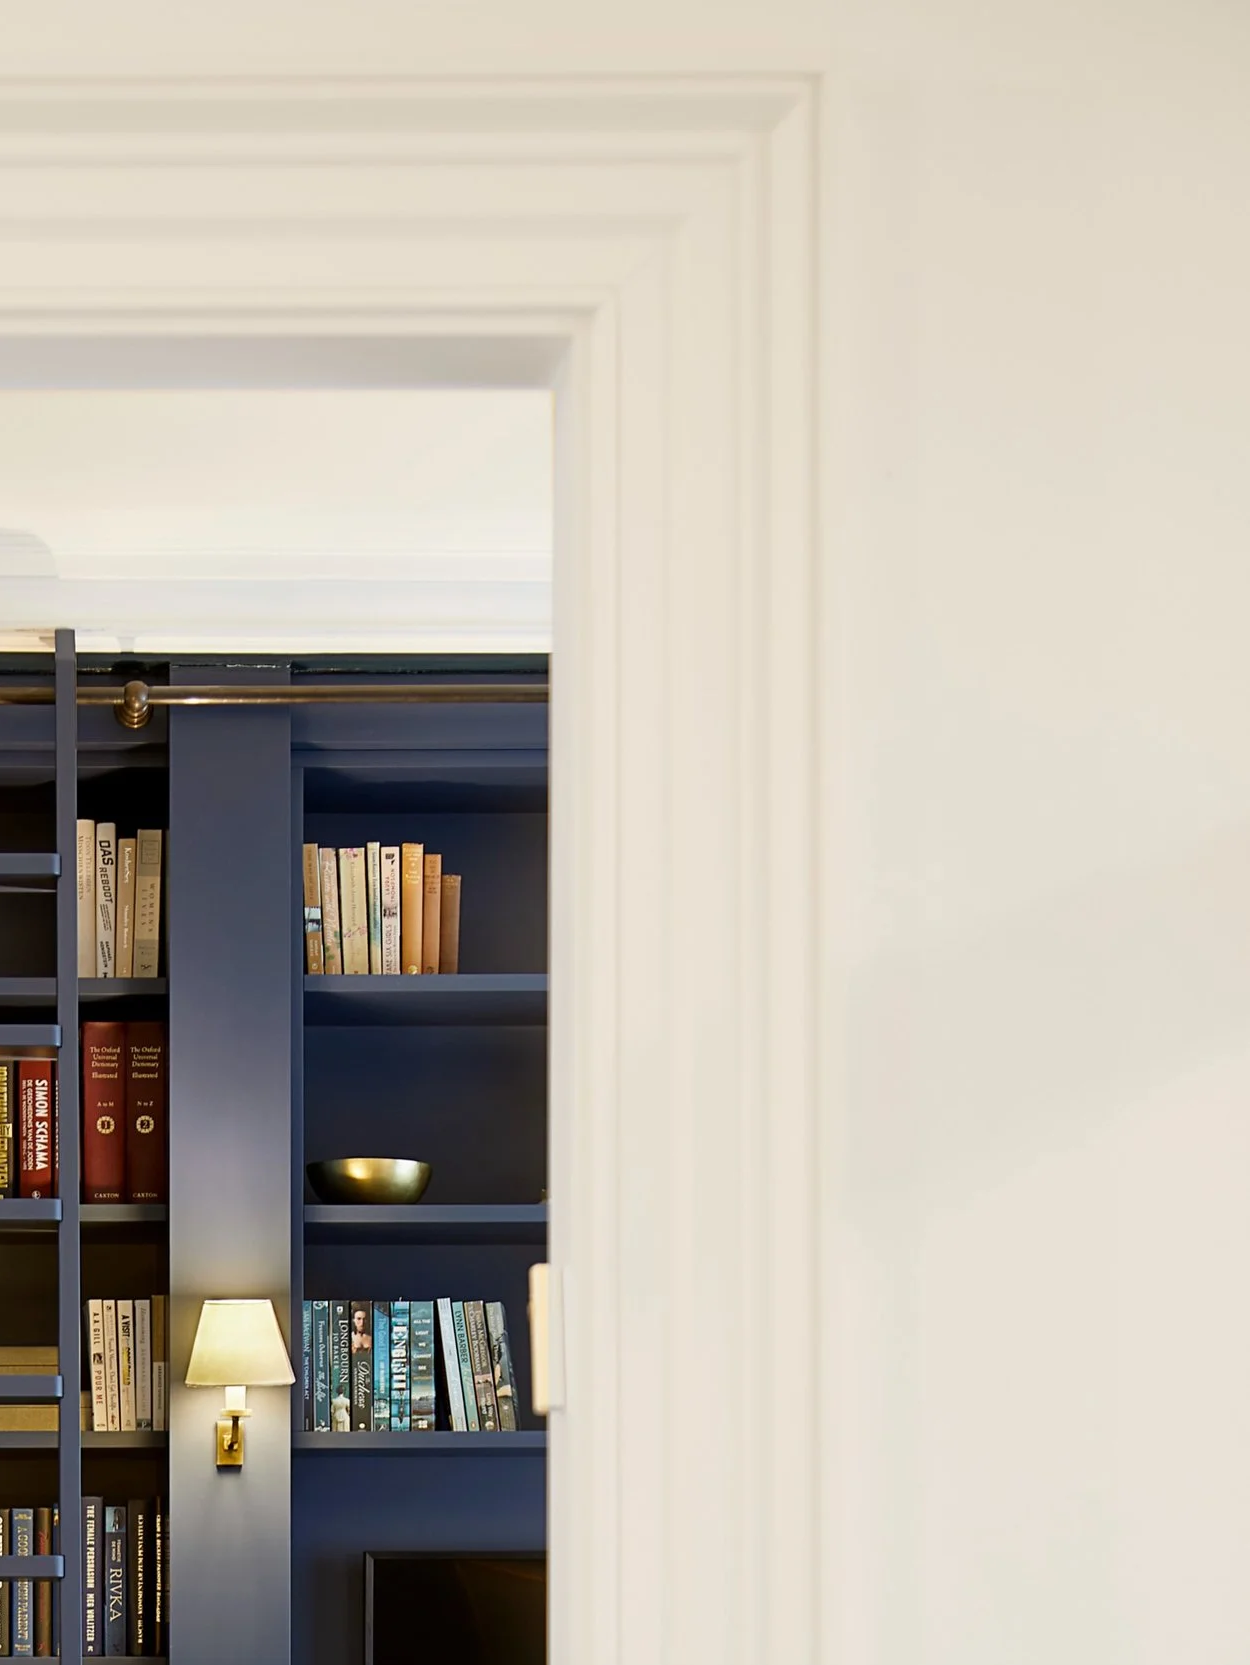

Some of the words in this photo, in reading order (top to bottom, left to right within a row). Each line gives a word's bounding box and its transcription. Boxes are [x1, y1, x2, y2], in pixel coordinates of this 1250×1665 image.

[99, 840, 114, 866] DAS
[99, 867, 113, 904] REBOOT
[91, 1061, 119, 1069] Dictionary
[132, 1061, 159, 1069] Dictionary
[27, 1079, 33, 1087] DE
[35, 1079, 48, 1117] SIMON
[27, 1142, 33, 1150] DE
[35, 1121, 48, 1170] SCHAMA
[122, 1321, 131, 1337] VISIT
[378, 1318, 387, 1328] The
[455, 1311, 464, 1331] LYNN
[468, 1311, 477, 1339] CHARLEY
[93, 1328, 101, 1345] GILL
[333, 1333, 339, 1342] JO
[378, 1329, 387, 1349] Good
[457, 1333, 468, 1363] BARBER
[476, 1329, 487, 1368] McGREGOR
[338, 1320, 349, 1383] LONGBOURN
[472, 1340, 481, 1373] BOORMAN
[357, 1361, 370, 1409] Duchess
[96, 1394, 103, 1405] ME
[86, 1505, 95, 1518] THE
[86, 1519, 95, 1545] FEMALE
[86, 1546, 95, 1588] PERSUASION
[86, 1593, 95, 1607] MEG
[109, 1568, 122, 1622] RIVKA
[86, 1609, 95, 1642] WOLITZER
